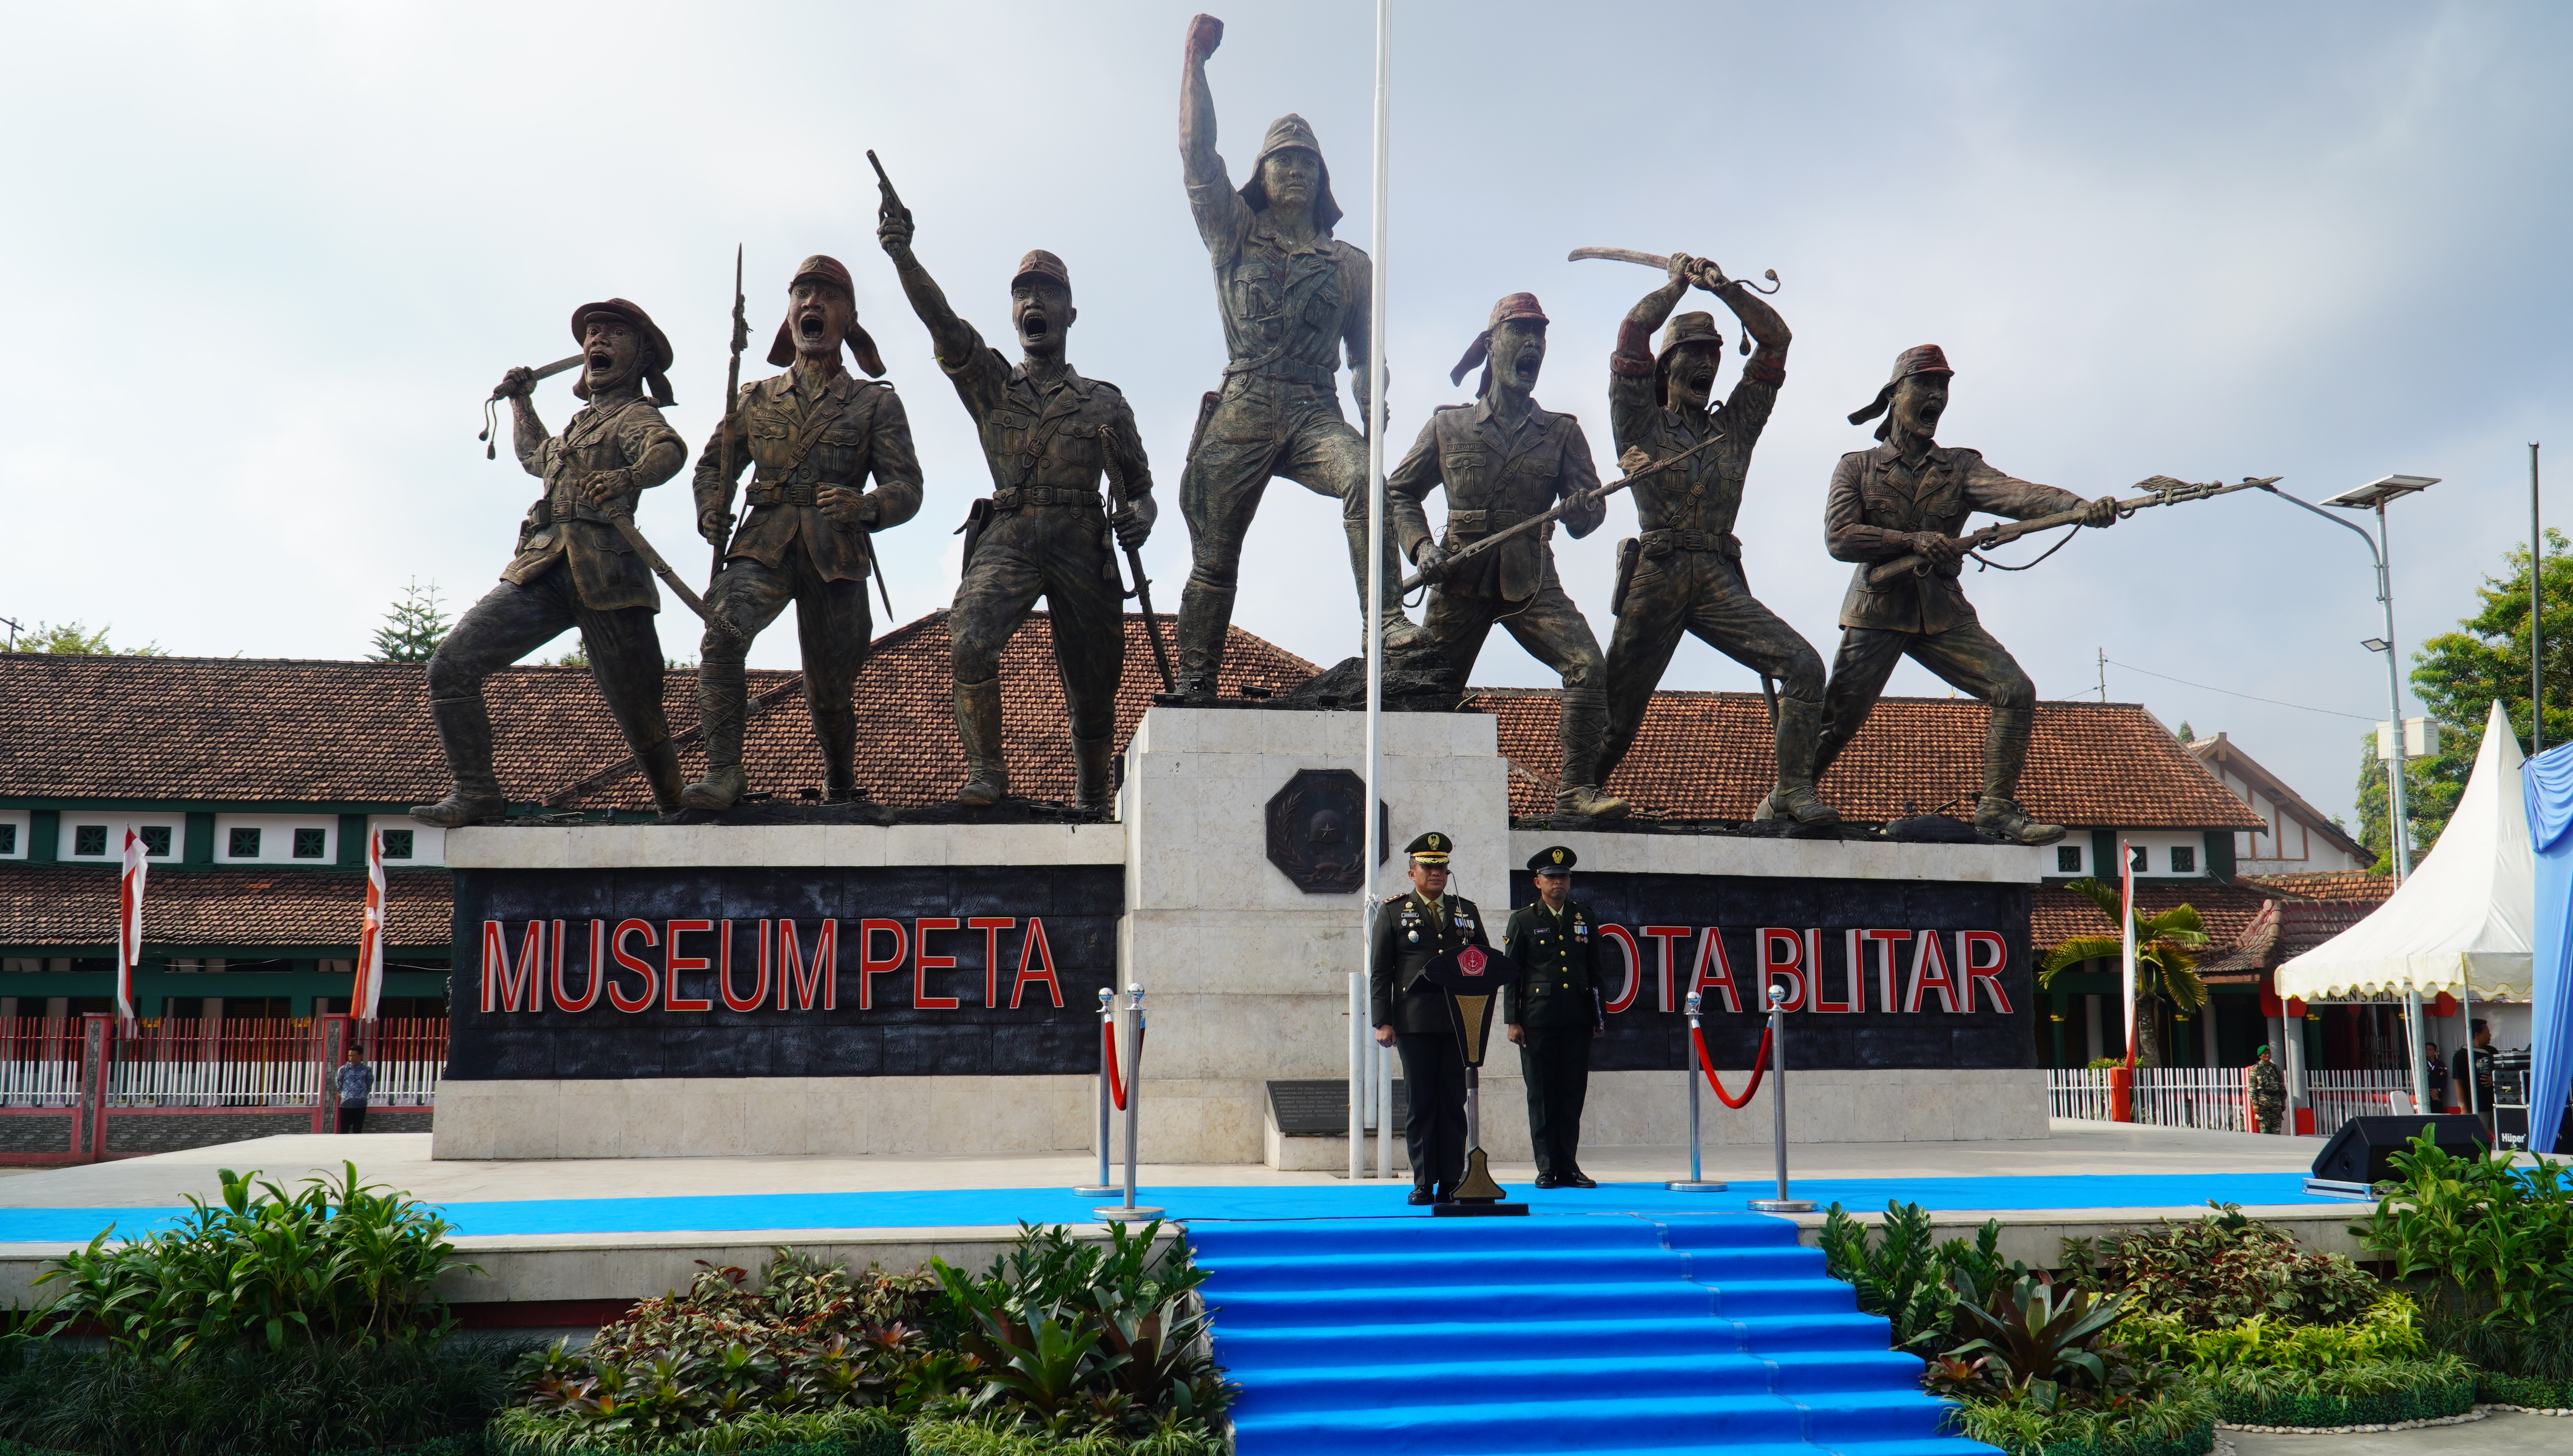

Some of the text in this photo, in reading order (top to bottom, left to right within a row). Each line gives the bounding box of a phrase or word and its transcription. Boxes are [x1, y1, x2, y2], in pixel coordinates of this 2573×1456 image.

[481, 916, 2013, 1014] MUSEUM PETA OTA BLITAR
[2318, 989, 2357, 1002] MKN
[2501, 1133, 2525, 1144] Hüper
